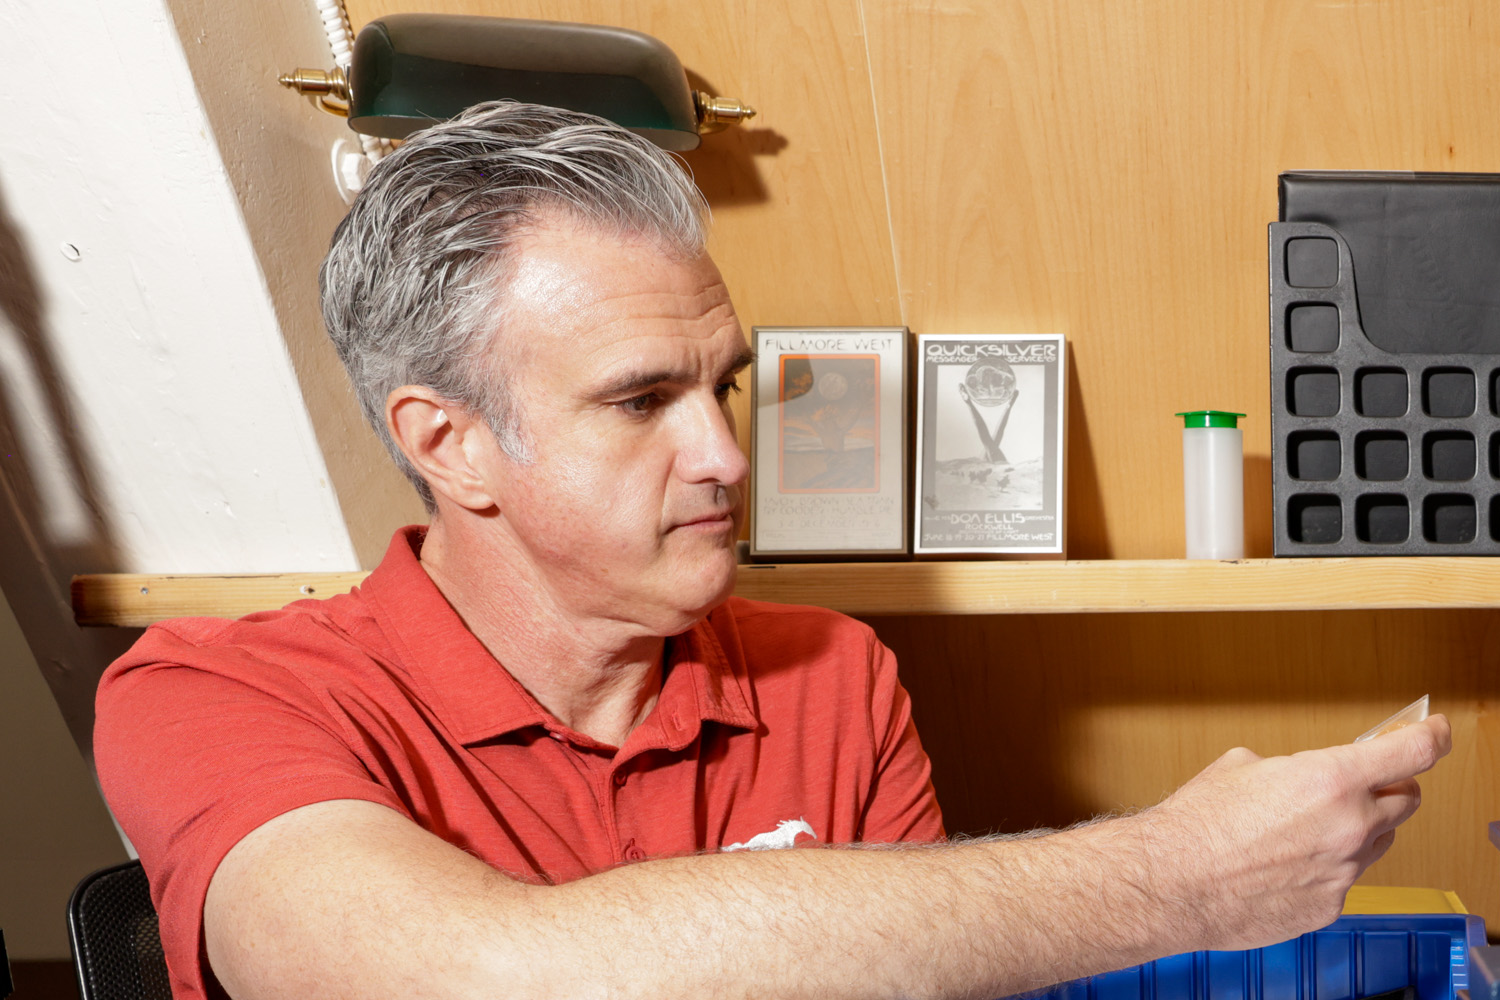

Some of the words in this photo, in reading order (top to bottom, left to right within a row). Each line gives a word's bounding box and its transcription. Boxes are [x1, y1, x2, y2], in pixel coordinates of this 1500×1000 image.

[765, 338, 846, 350] FILLMORE
[855, 338, 893, 350] WEST
[926, 344, 1057, 357] QUICKSILVER
[985, 512, 1026, 524] ELLIS
[986, 532, 1029, 541] FILLMORE
[1031, 532, 1054, 541] WEST
